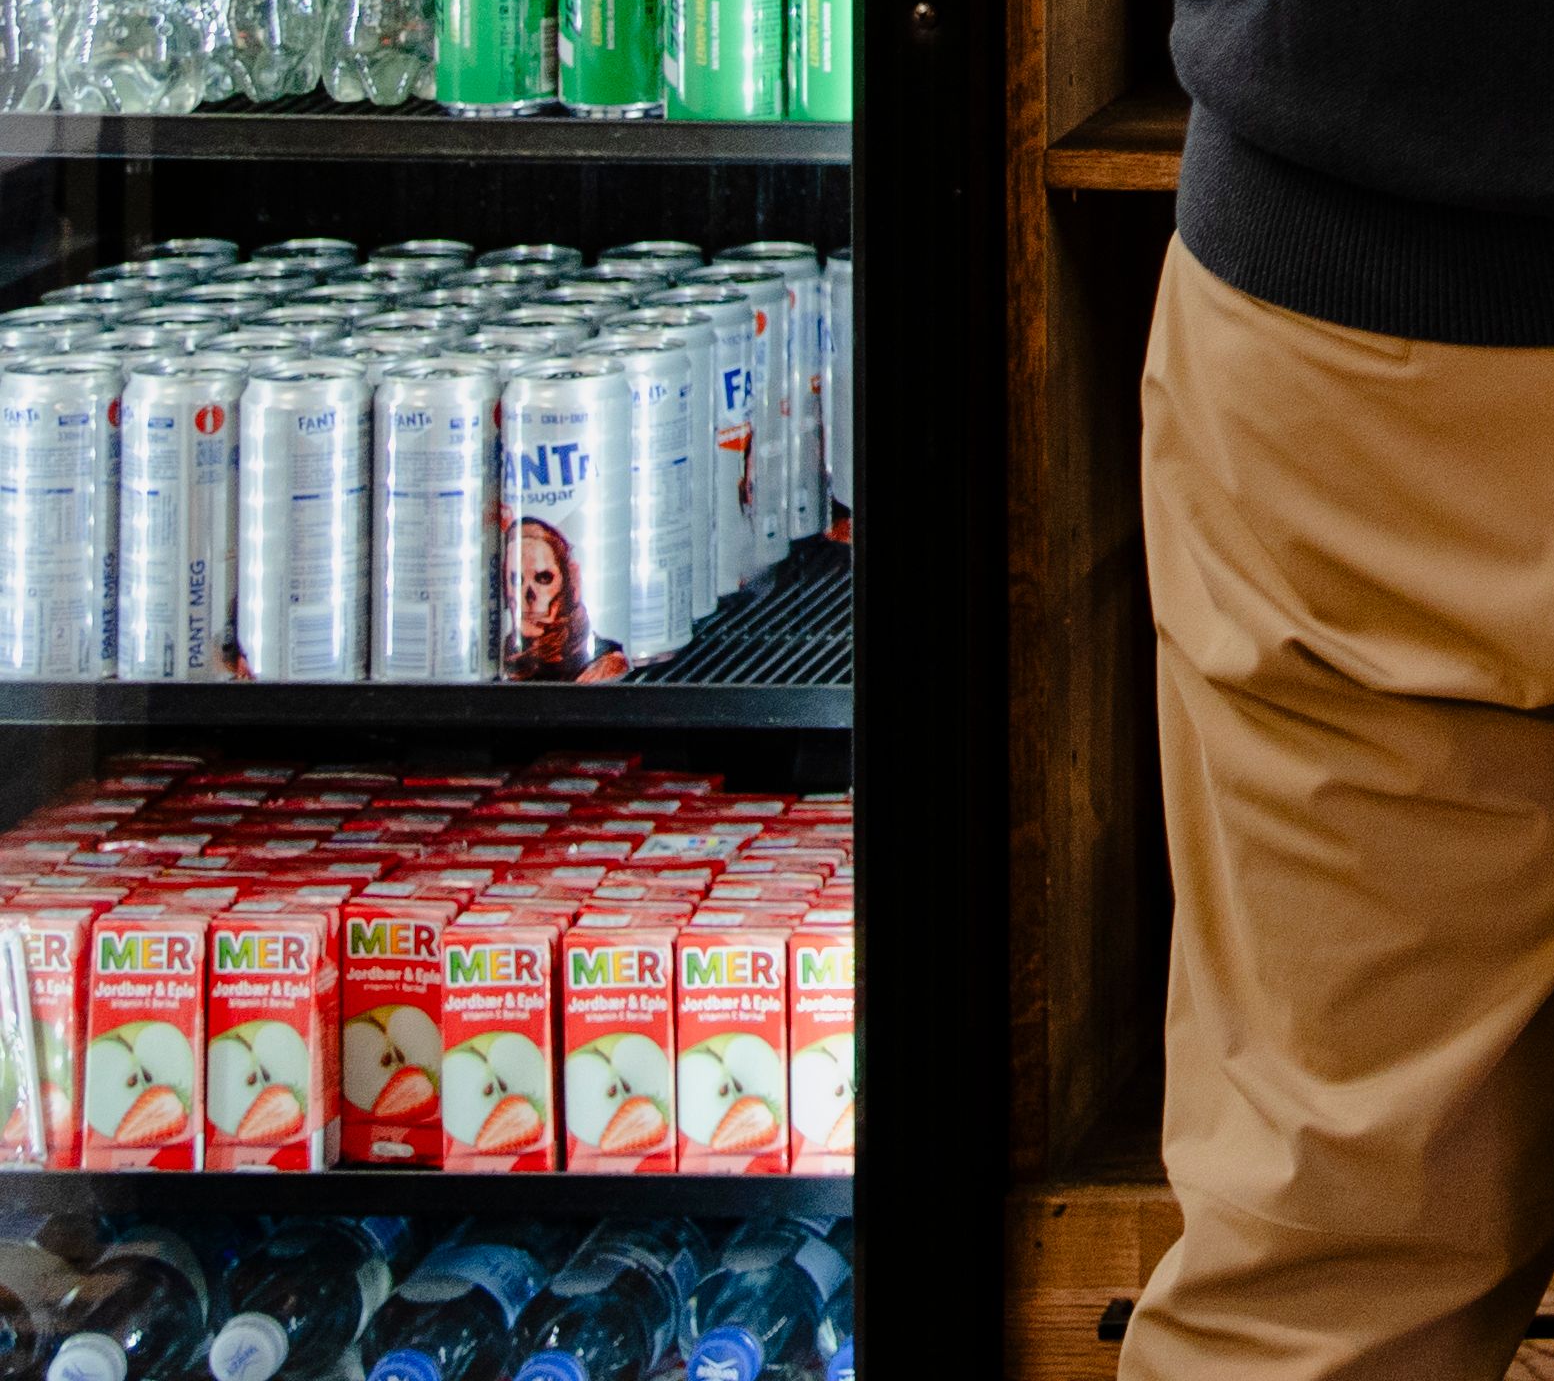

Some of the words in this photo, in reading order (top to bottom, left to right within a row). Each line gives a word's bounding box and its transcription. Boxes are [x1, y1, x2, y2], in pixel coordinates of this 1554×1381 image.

[528, 489, 574, 506] sugar
[189, 559, 206, 606] MEG
[188, 614, 205, 668] PANT
[100, 935, 192, 970] MER
[217, 935, 306, 970] MER
[350, 923, 437, 957] MER
[449, 946, 541, 985] MER
[572, 951, 662, 986] MER
[685, 951, 775, 985] MER
